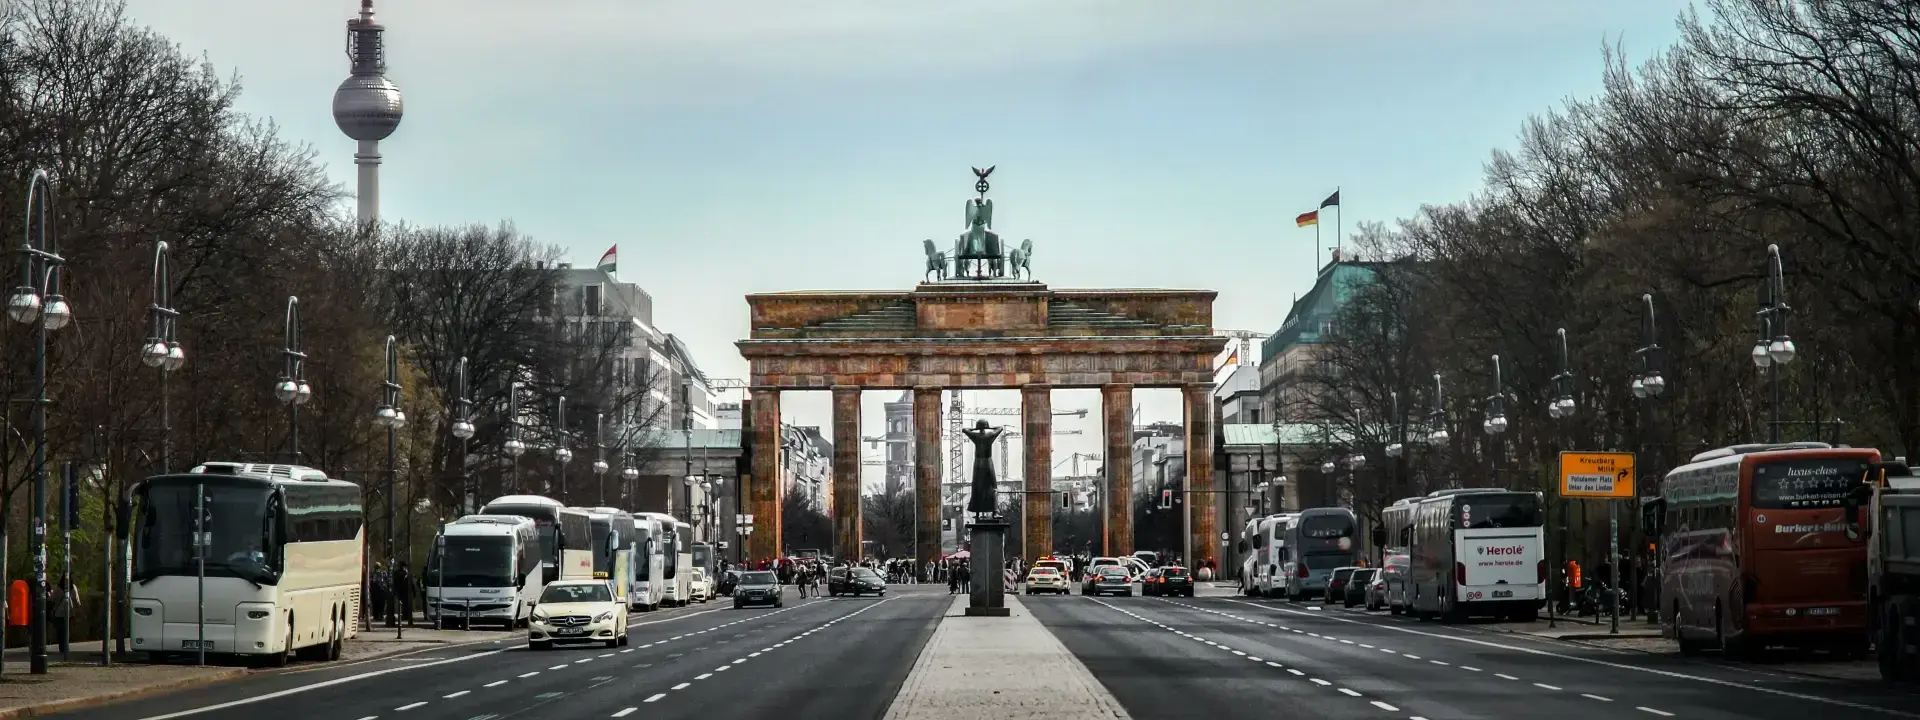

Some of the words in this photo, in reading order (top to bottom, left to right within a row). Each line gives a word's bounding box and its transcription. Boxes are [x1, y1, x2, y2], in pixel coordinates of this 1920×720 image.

[1579, 457, 1615, 465] Kreuzberg
[1787, 465, 1838, 477] luxus-class
[1486, 545, 1523, 556] Herolé
[1478, 559, 1523, 567] www.herole.de
